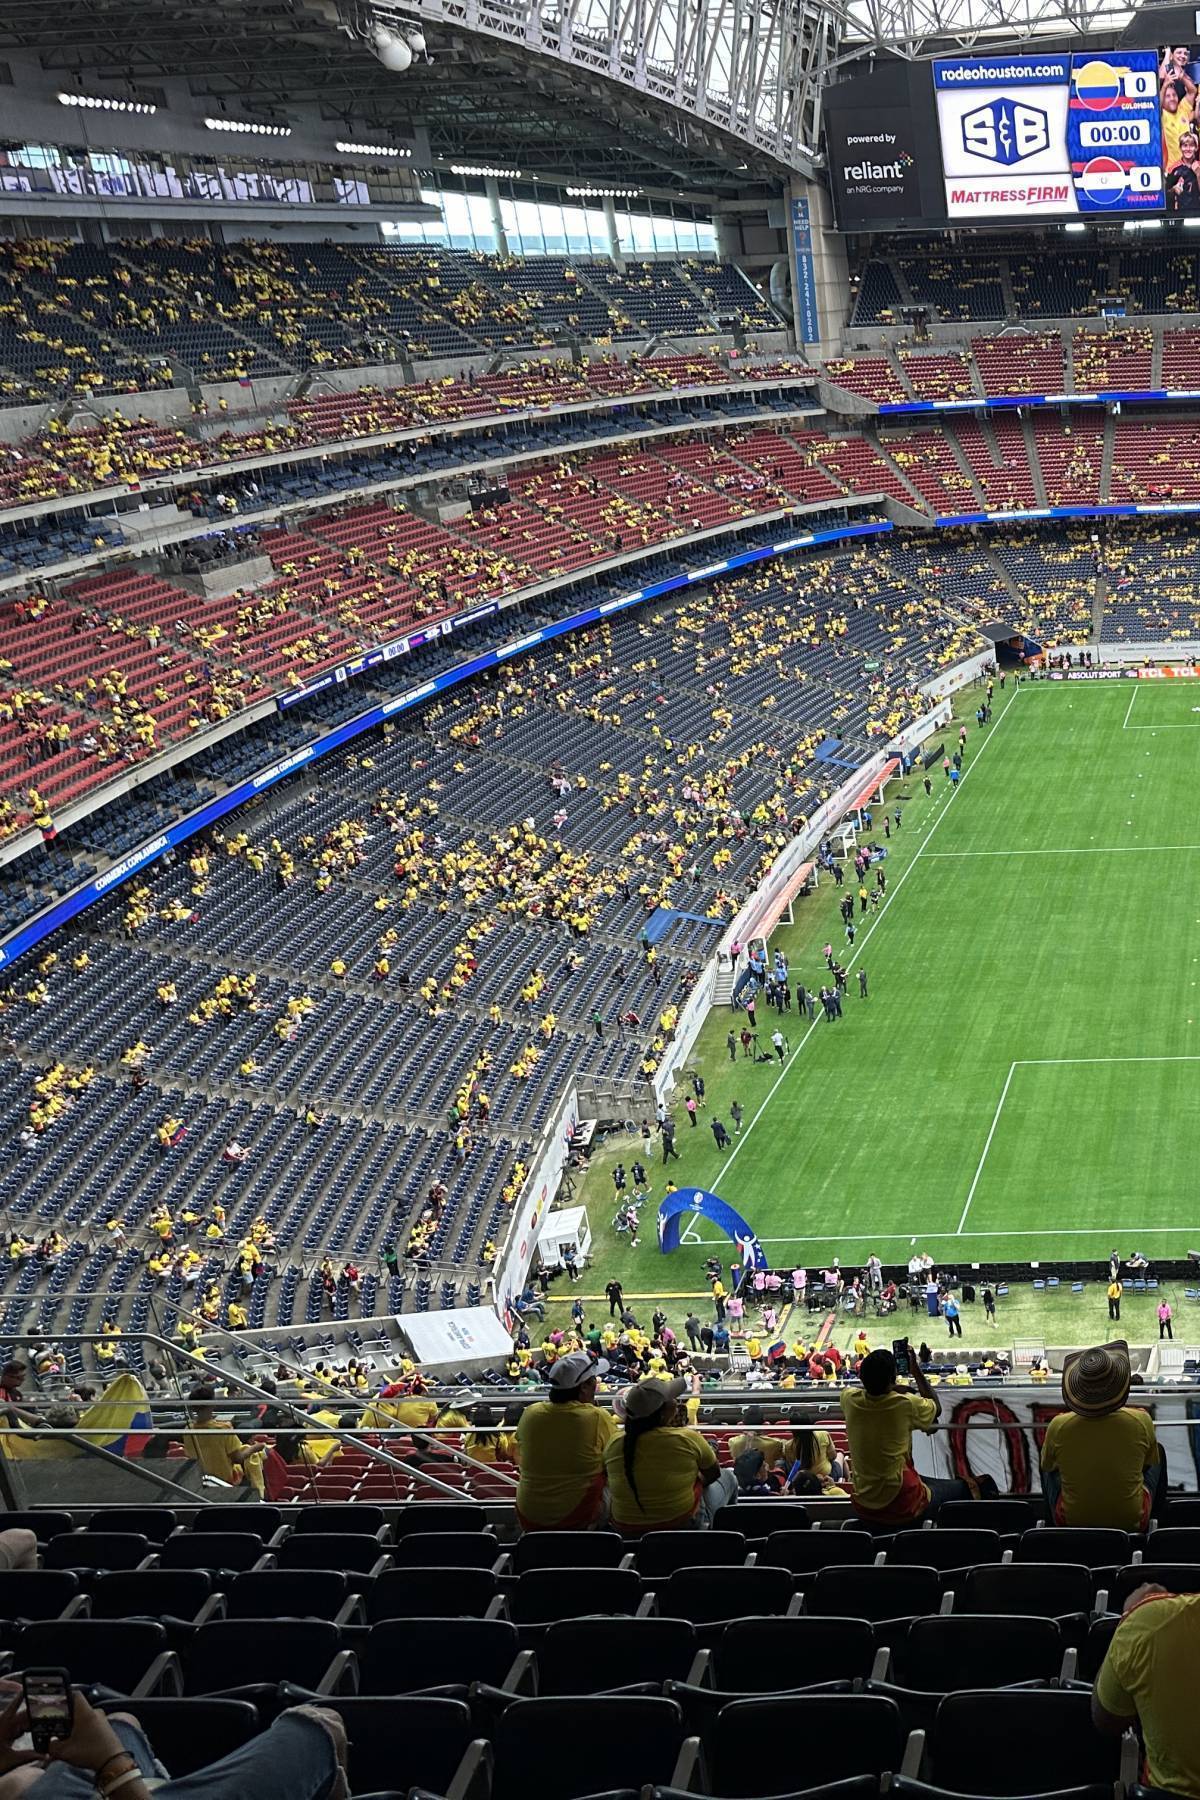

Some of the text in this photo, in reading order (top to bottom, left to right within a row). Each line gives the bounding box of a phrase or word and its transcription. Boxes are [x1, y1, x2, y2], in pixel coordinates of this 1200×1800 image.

[941, 64, 1064, 82] rodeohouston.com
[1135, 77, 1146, 93] 0
[1121, 102, 1155, 110] COLOMBIA
[847, 133, 896, 145] powered by
[963, 104, 1048, 161] S&B
[1090, 125, 1141, 143] 00:00
[843, 161, 903, 181] reliant
[1140, 172, 1151, 187] 0
[855, 186, 871, 194] NRG
[871, 185, 904, 195] company
[1067, 670, 1121, 679] ABSOLUT SPORT
[1140, 668, 1166, 678] TCL
[1172, 667, 1198, 677] TCL
